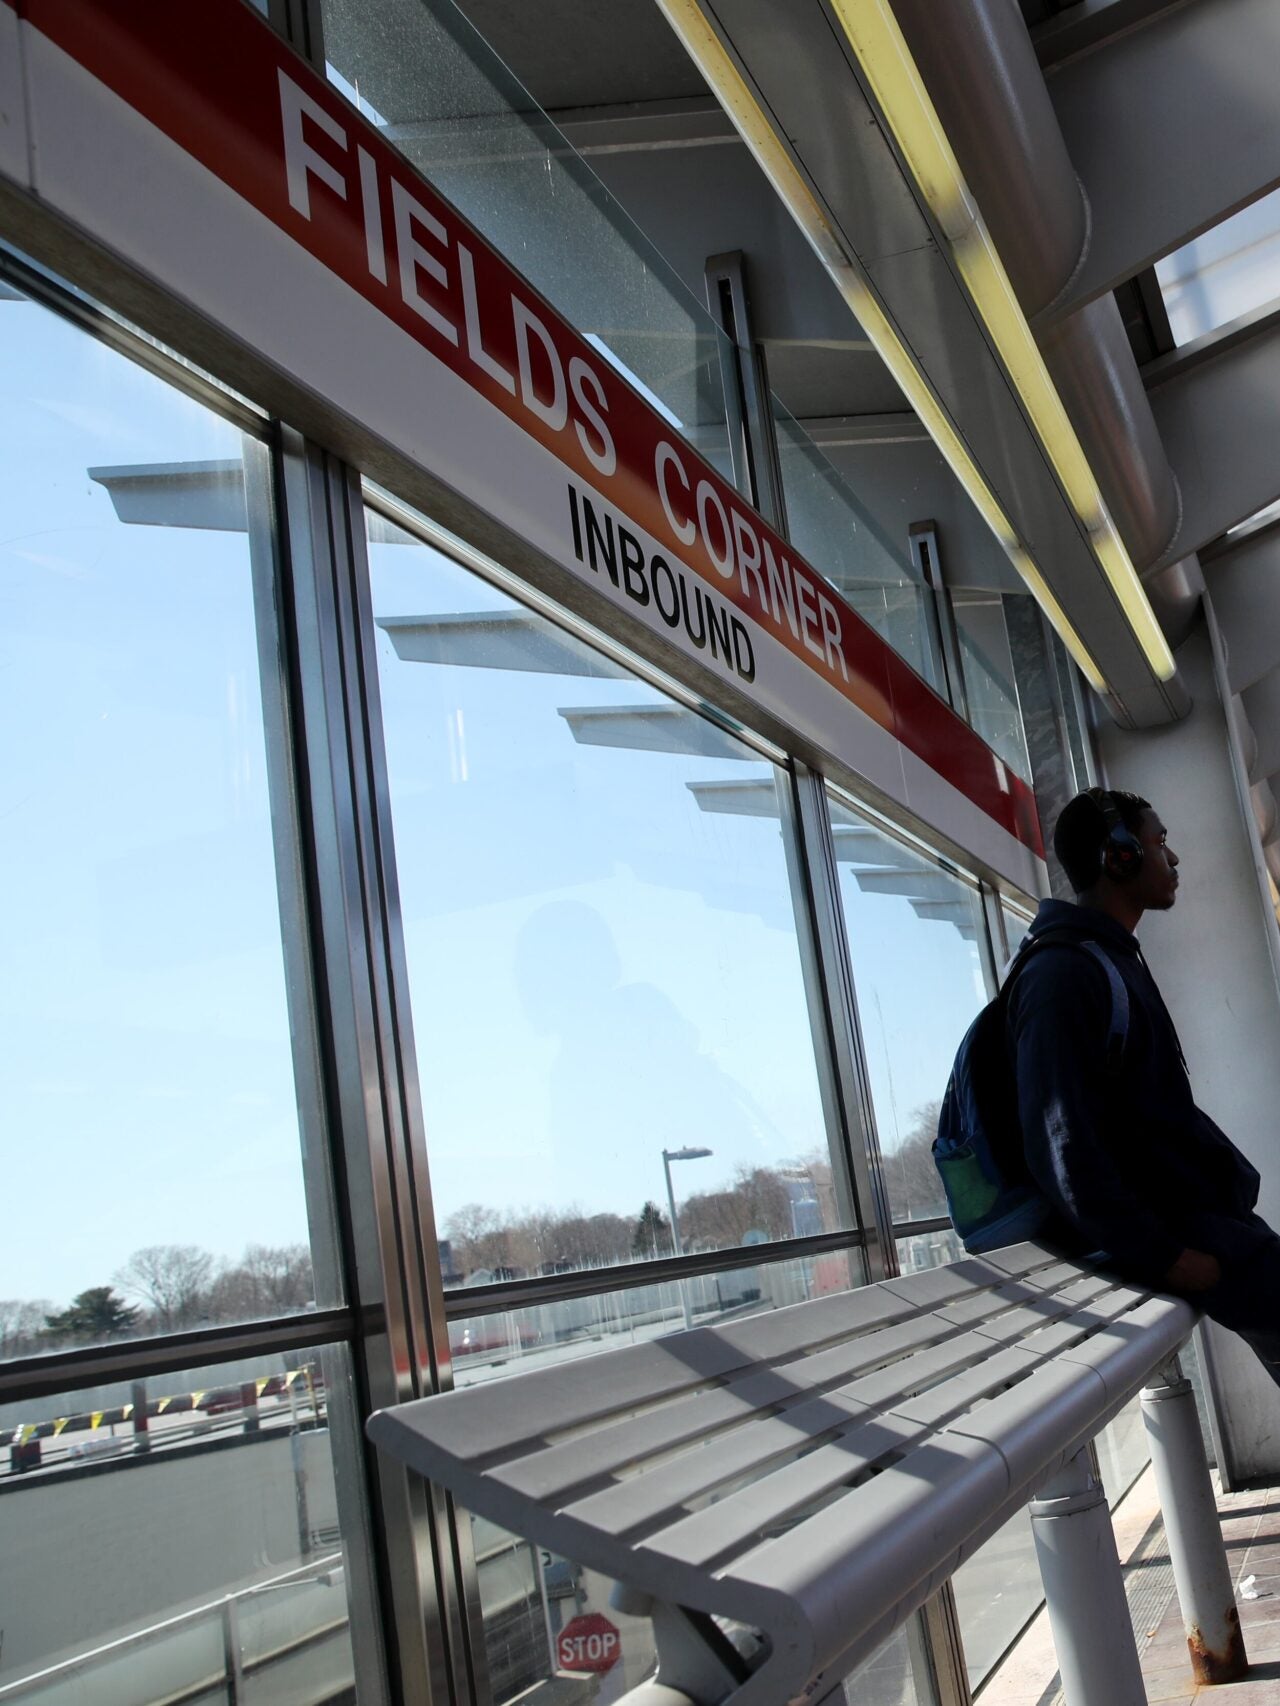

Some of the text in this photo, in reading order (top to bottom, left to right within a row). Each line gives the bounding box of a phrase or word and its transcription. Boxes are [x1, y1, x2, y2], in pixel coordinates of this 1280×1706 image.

[277, 66, 850, 683] FIELDS CORNER
[567, 483, 756, 685] INBOUND
[560, 1631, 617, 1663] STOP
